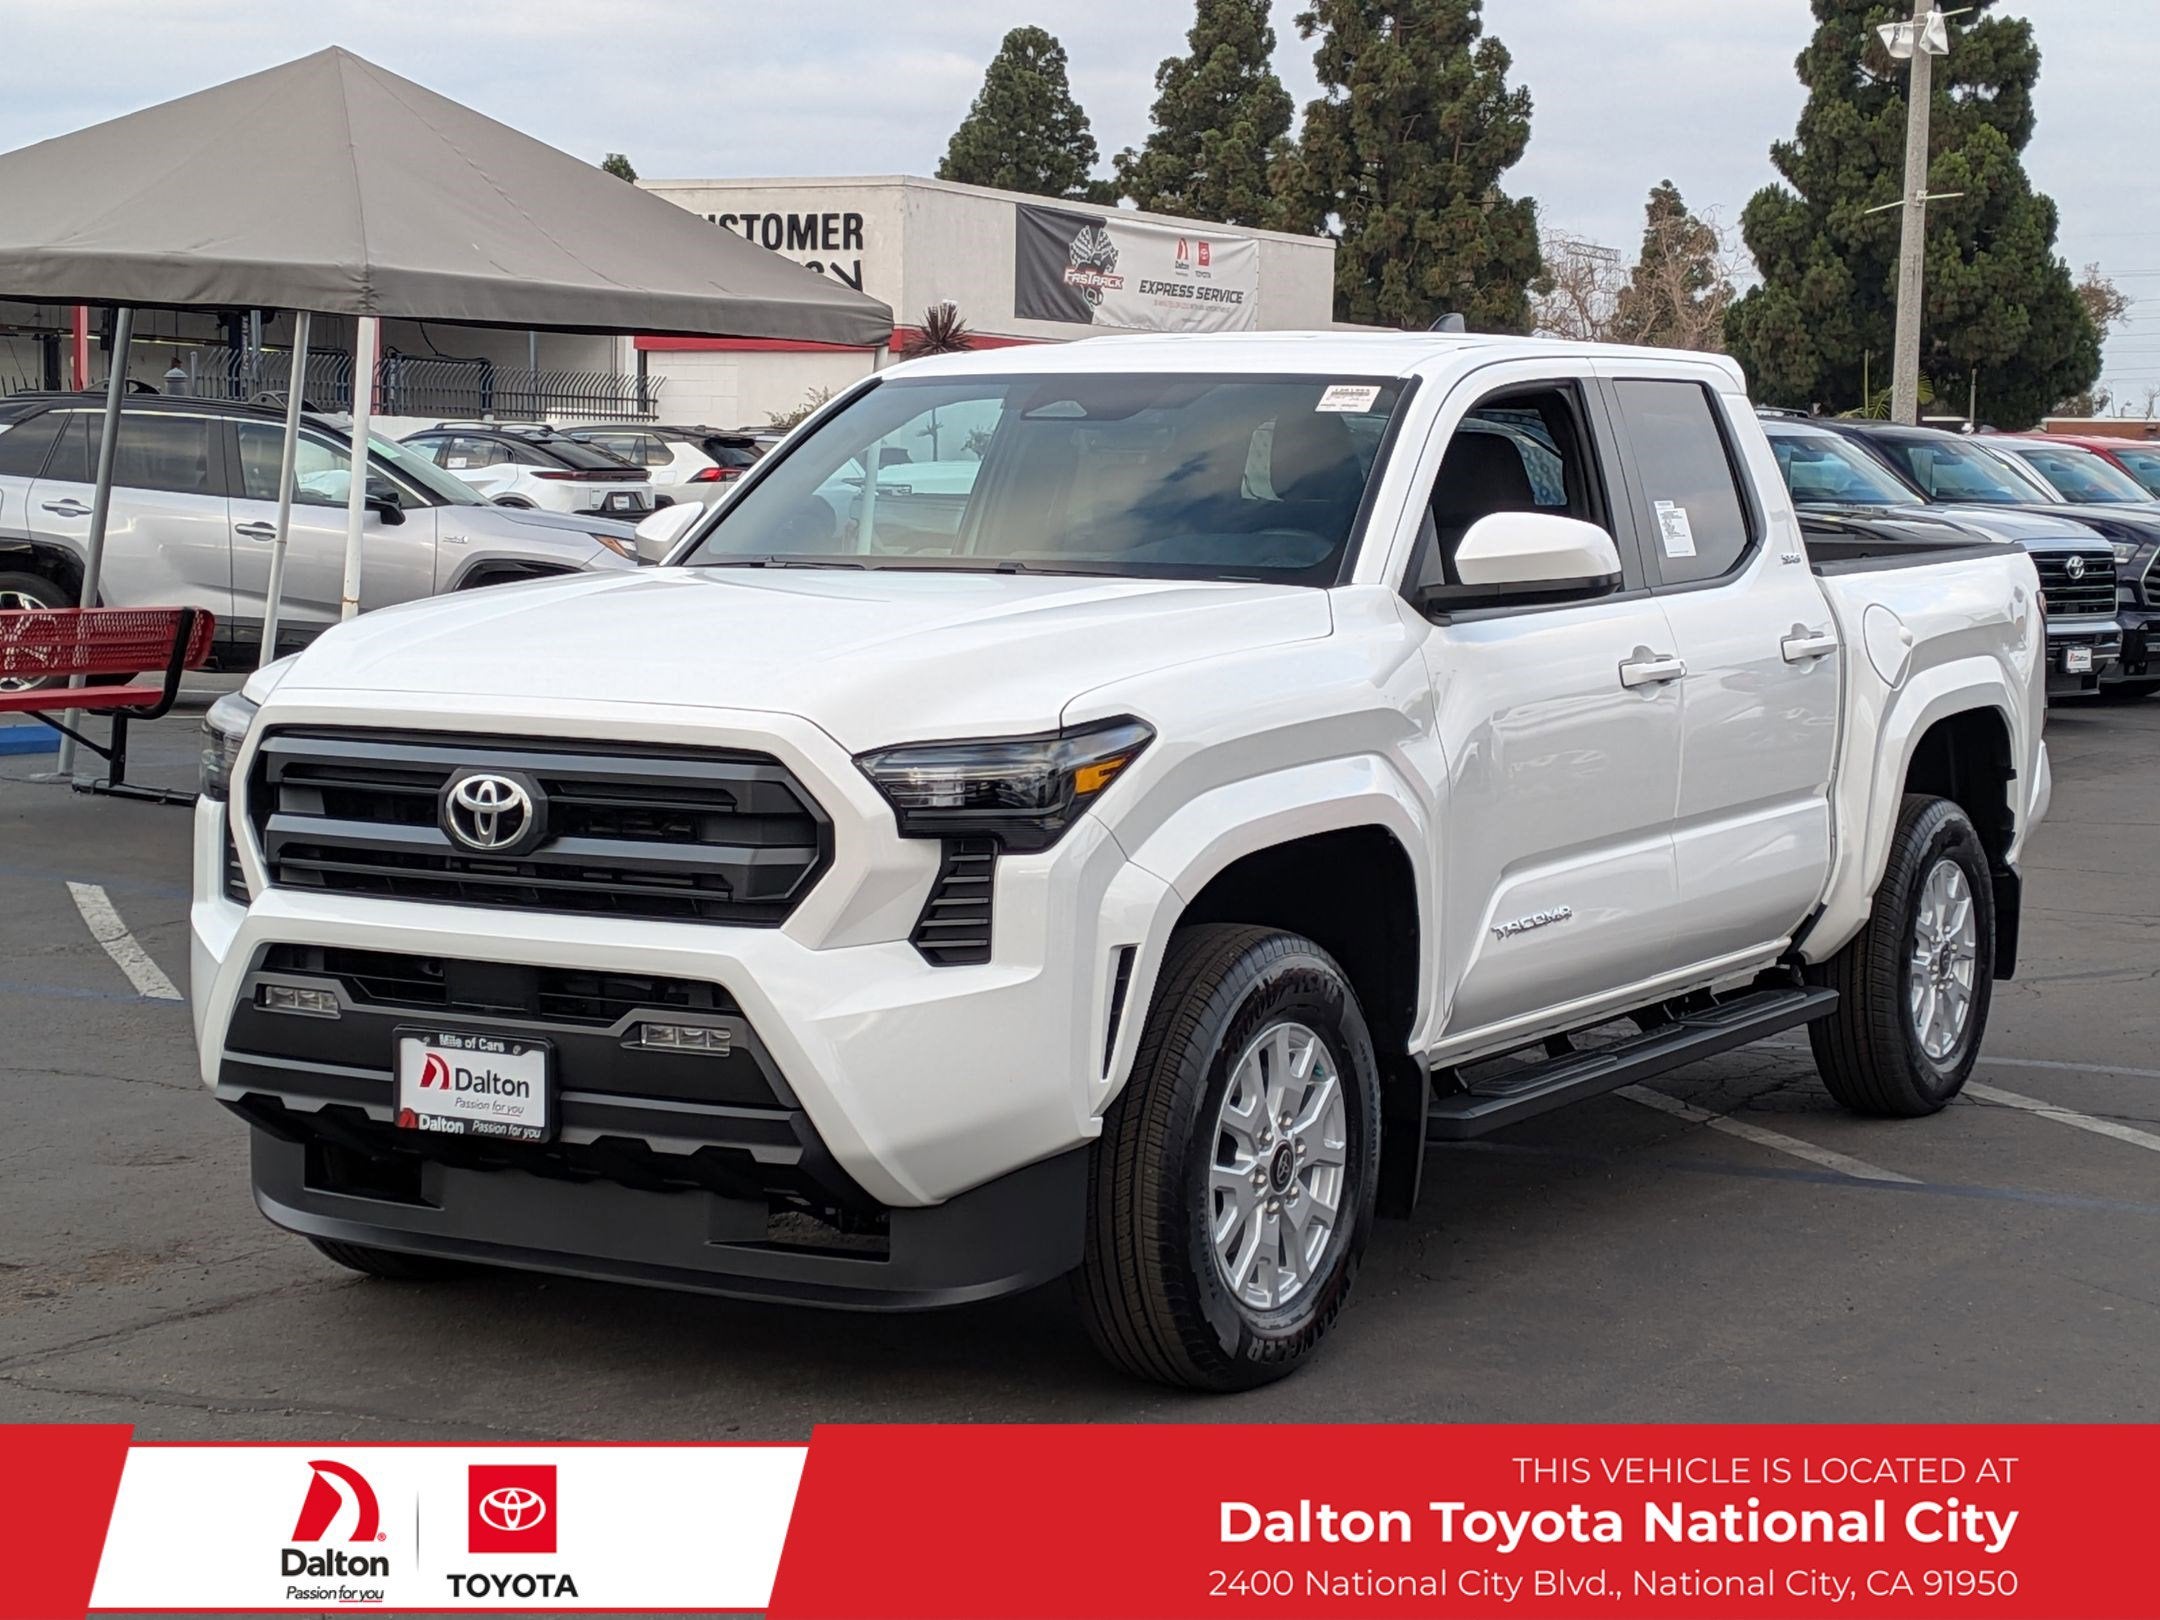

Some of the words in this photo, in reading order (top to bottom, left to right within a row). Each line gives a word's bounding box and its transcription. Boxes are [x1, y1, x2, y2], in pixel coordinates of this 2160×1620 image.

[1138, 280, 1195, 299] EXPRESS
[1195, 286, 1244, 304] SERVICE
[1491, 905, 1572, 941] TACOMA
[439, 1033, 463, 1048] Mile
[465, 1036, 477, 1049] of
[478, 1037, 505, 1053] Cars
[455, 1067, 530, 1099] Dalton
[454, 1097, 490, 1111] Passion
[492, 1100, 506, 1114] for
[507, 1104, 525, 1115] you
[418, 1114, 465, 1135] Dalton
[472, 1119, 507, 1135] Passion
[508, 1123, 522, 1137] for
[522, 1127, 542, 1140] you
